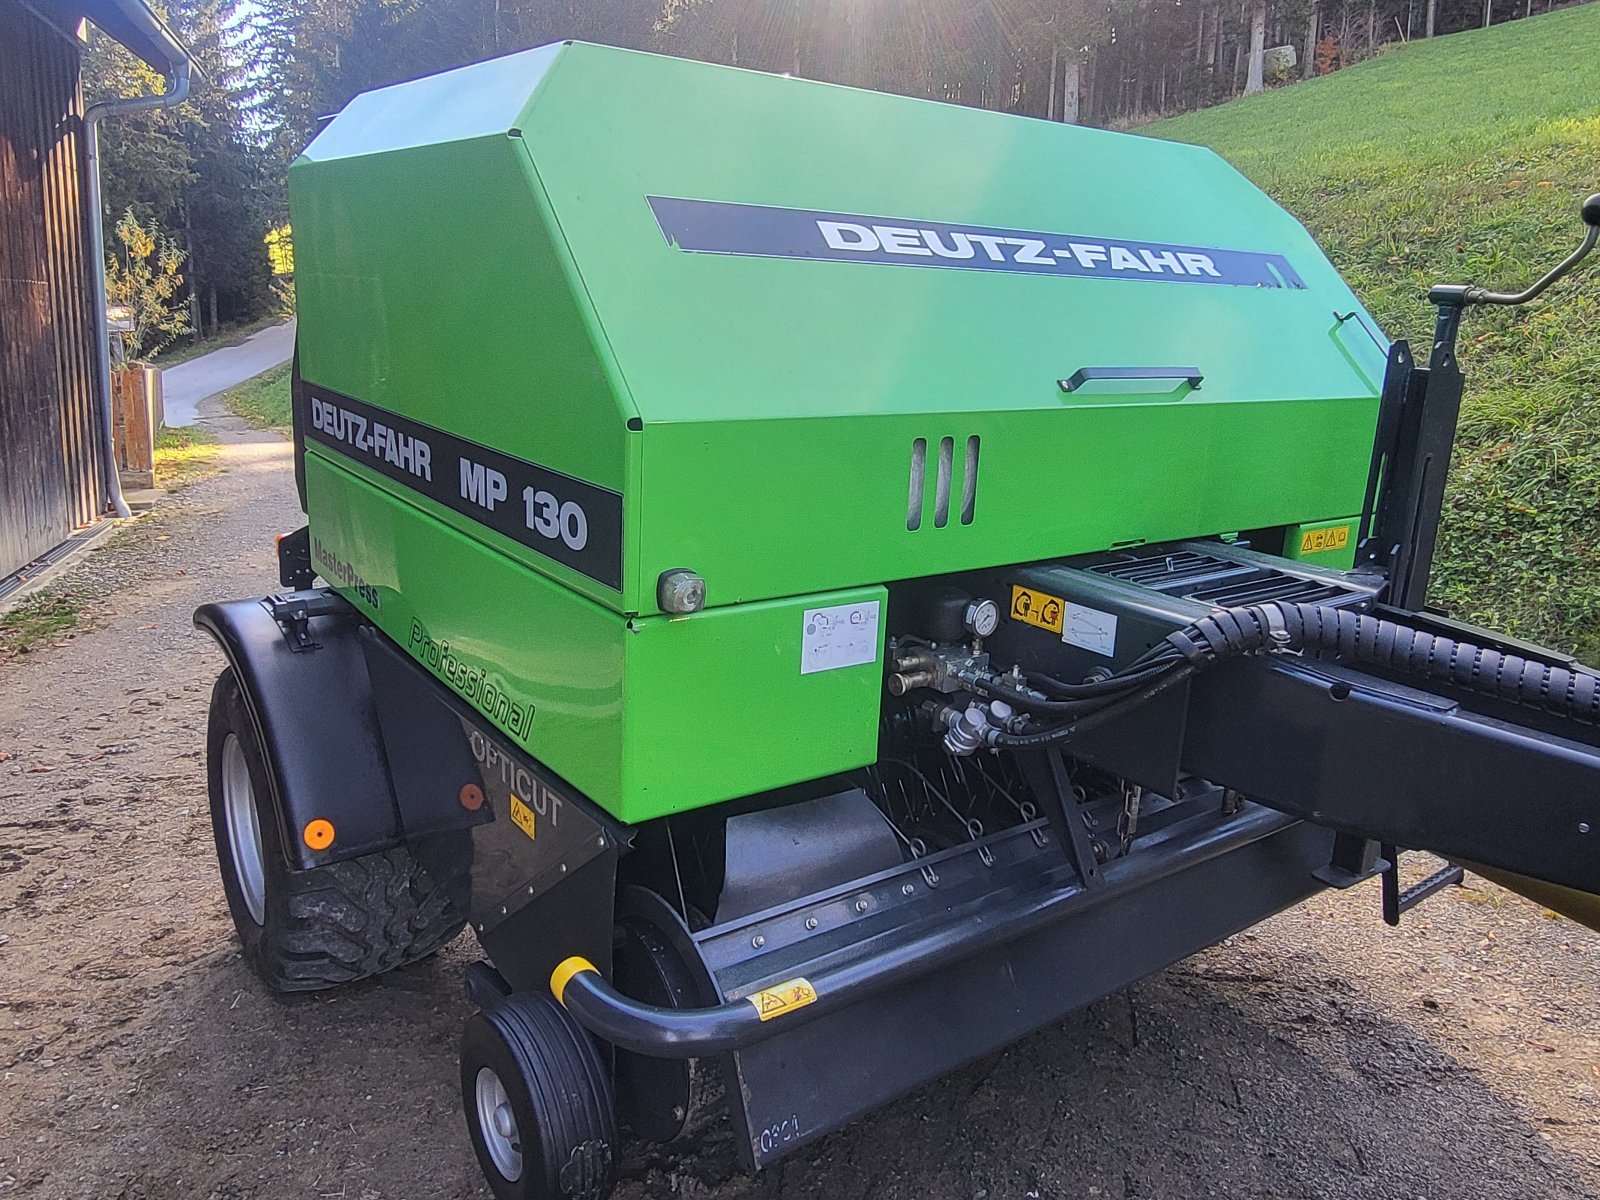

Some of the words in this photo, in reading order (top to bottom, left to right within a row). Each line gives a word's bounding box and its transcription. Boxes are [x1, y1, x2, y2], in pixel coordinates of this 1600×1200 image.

[816, 220, 1222, 277] DEUTZ-FAHR
[311, 397, 432, 482] DEUTZ-FAHR
[460, 456, 508, 512] MP
[522, 486, 588, 551] 130
[314, 536, 379, 610] MasterPress
[408, 616, 536, 742] Professional
[470, 731, 563, 828] OPTICUT
